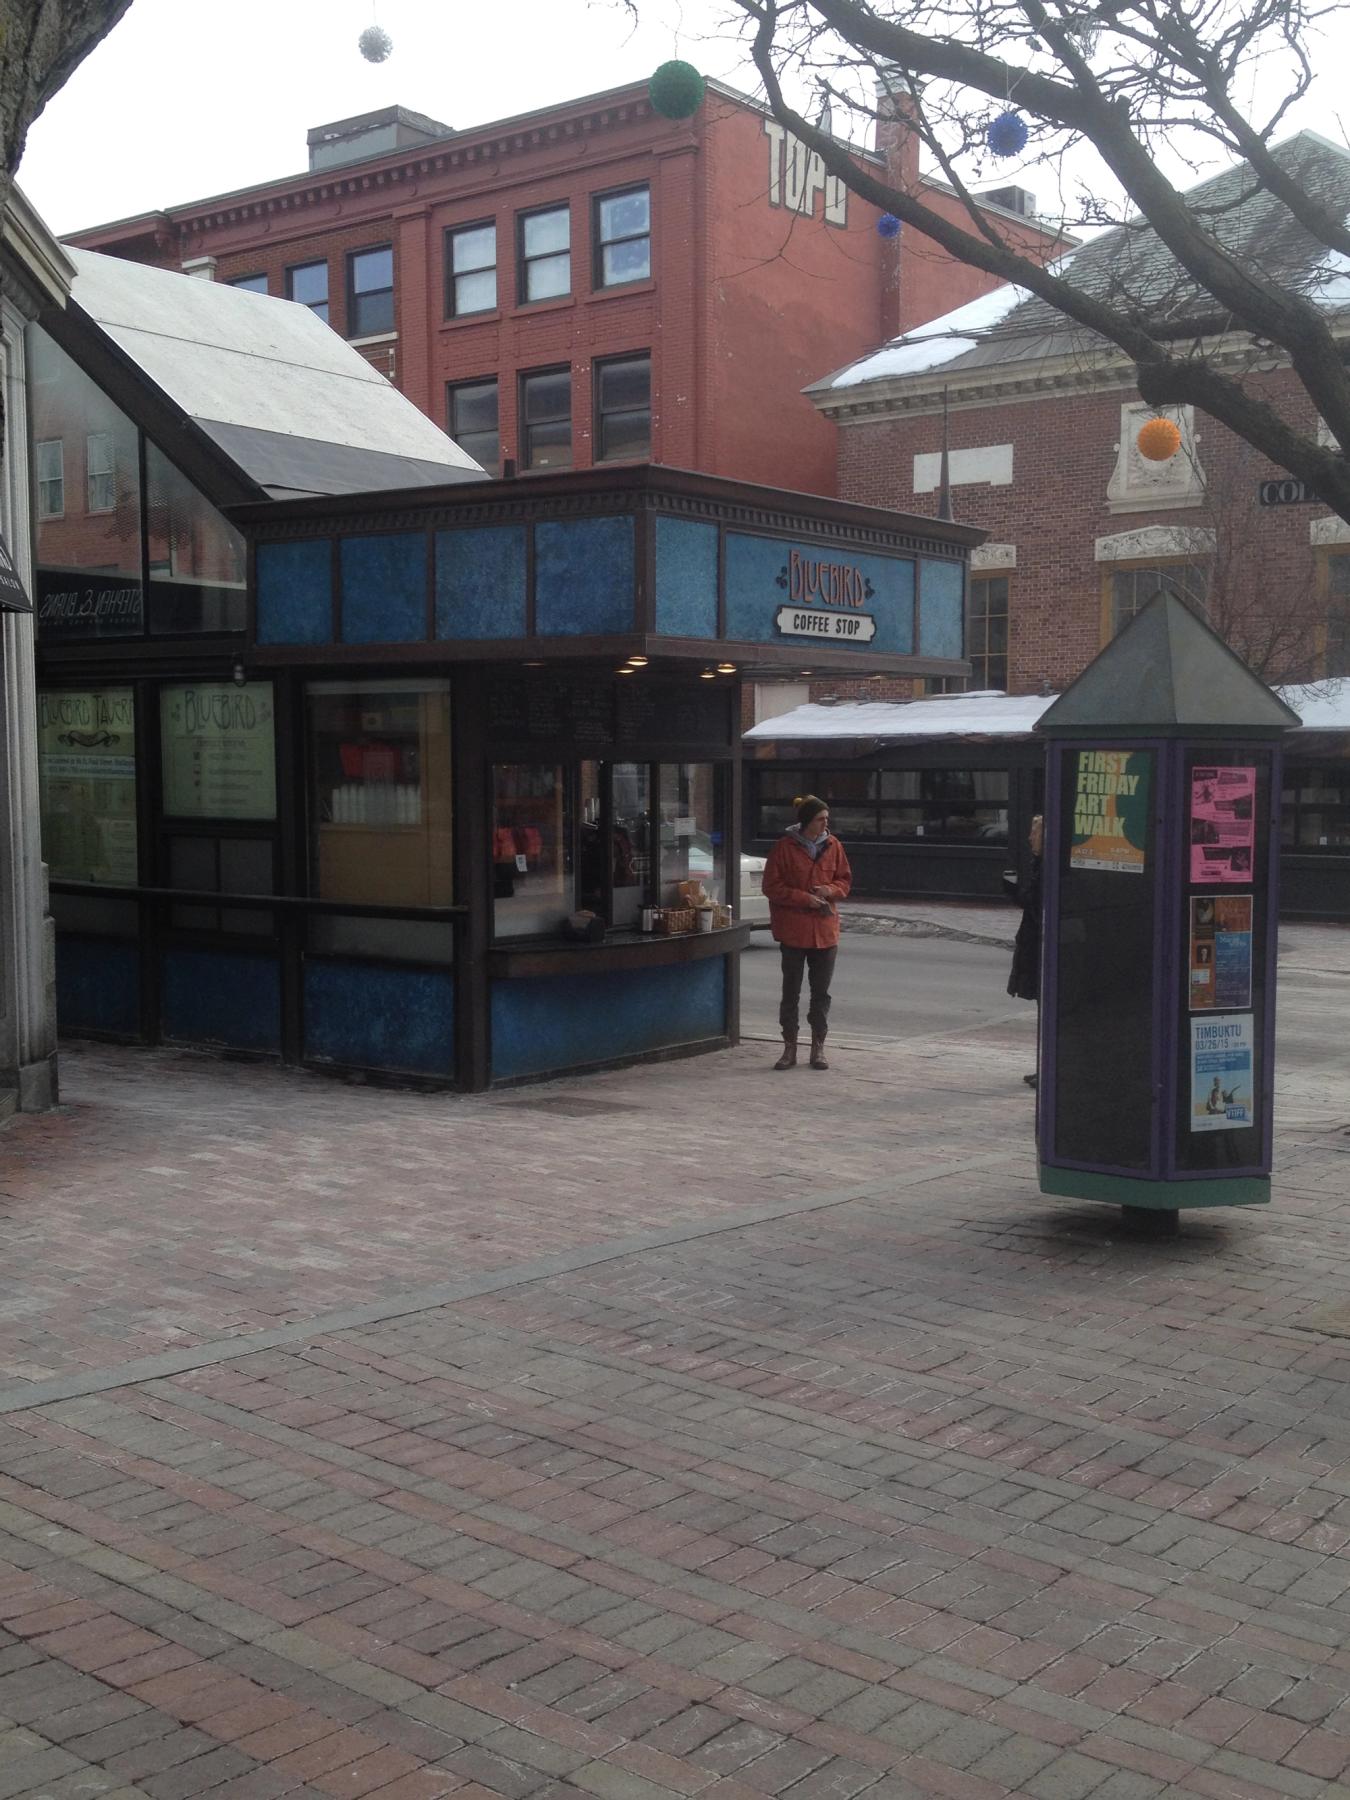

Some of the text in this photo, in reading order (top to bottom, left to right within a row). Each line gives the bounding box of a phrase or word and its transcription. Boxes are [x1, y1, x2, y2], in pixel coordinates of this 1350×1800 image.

[788, 550, 865, 608] BLUEBIRD
[793, 614, 861, 636] COFFEE STOP
[184, 690, 256, 734] BLUEBIRD
[1078, 751, 1133, 774] FIRST
[1077, 772, 1140, 796] FRIDAY
[1074, 793, 1110, 815] ART
[1074, 814, 1126, 838] WALK
[1195, 1023, 1242, 1040] TIMBUKTU
